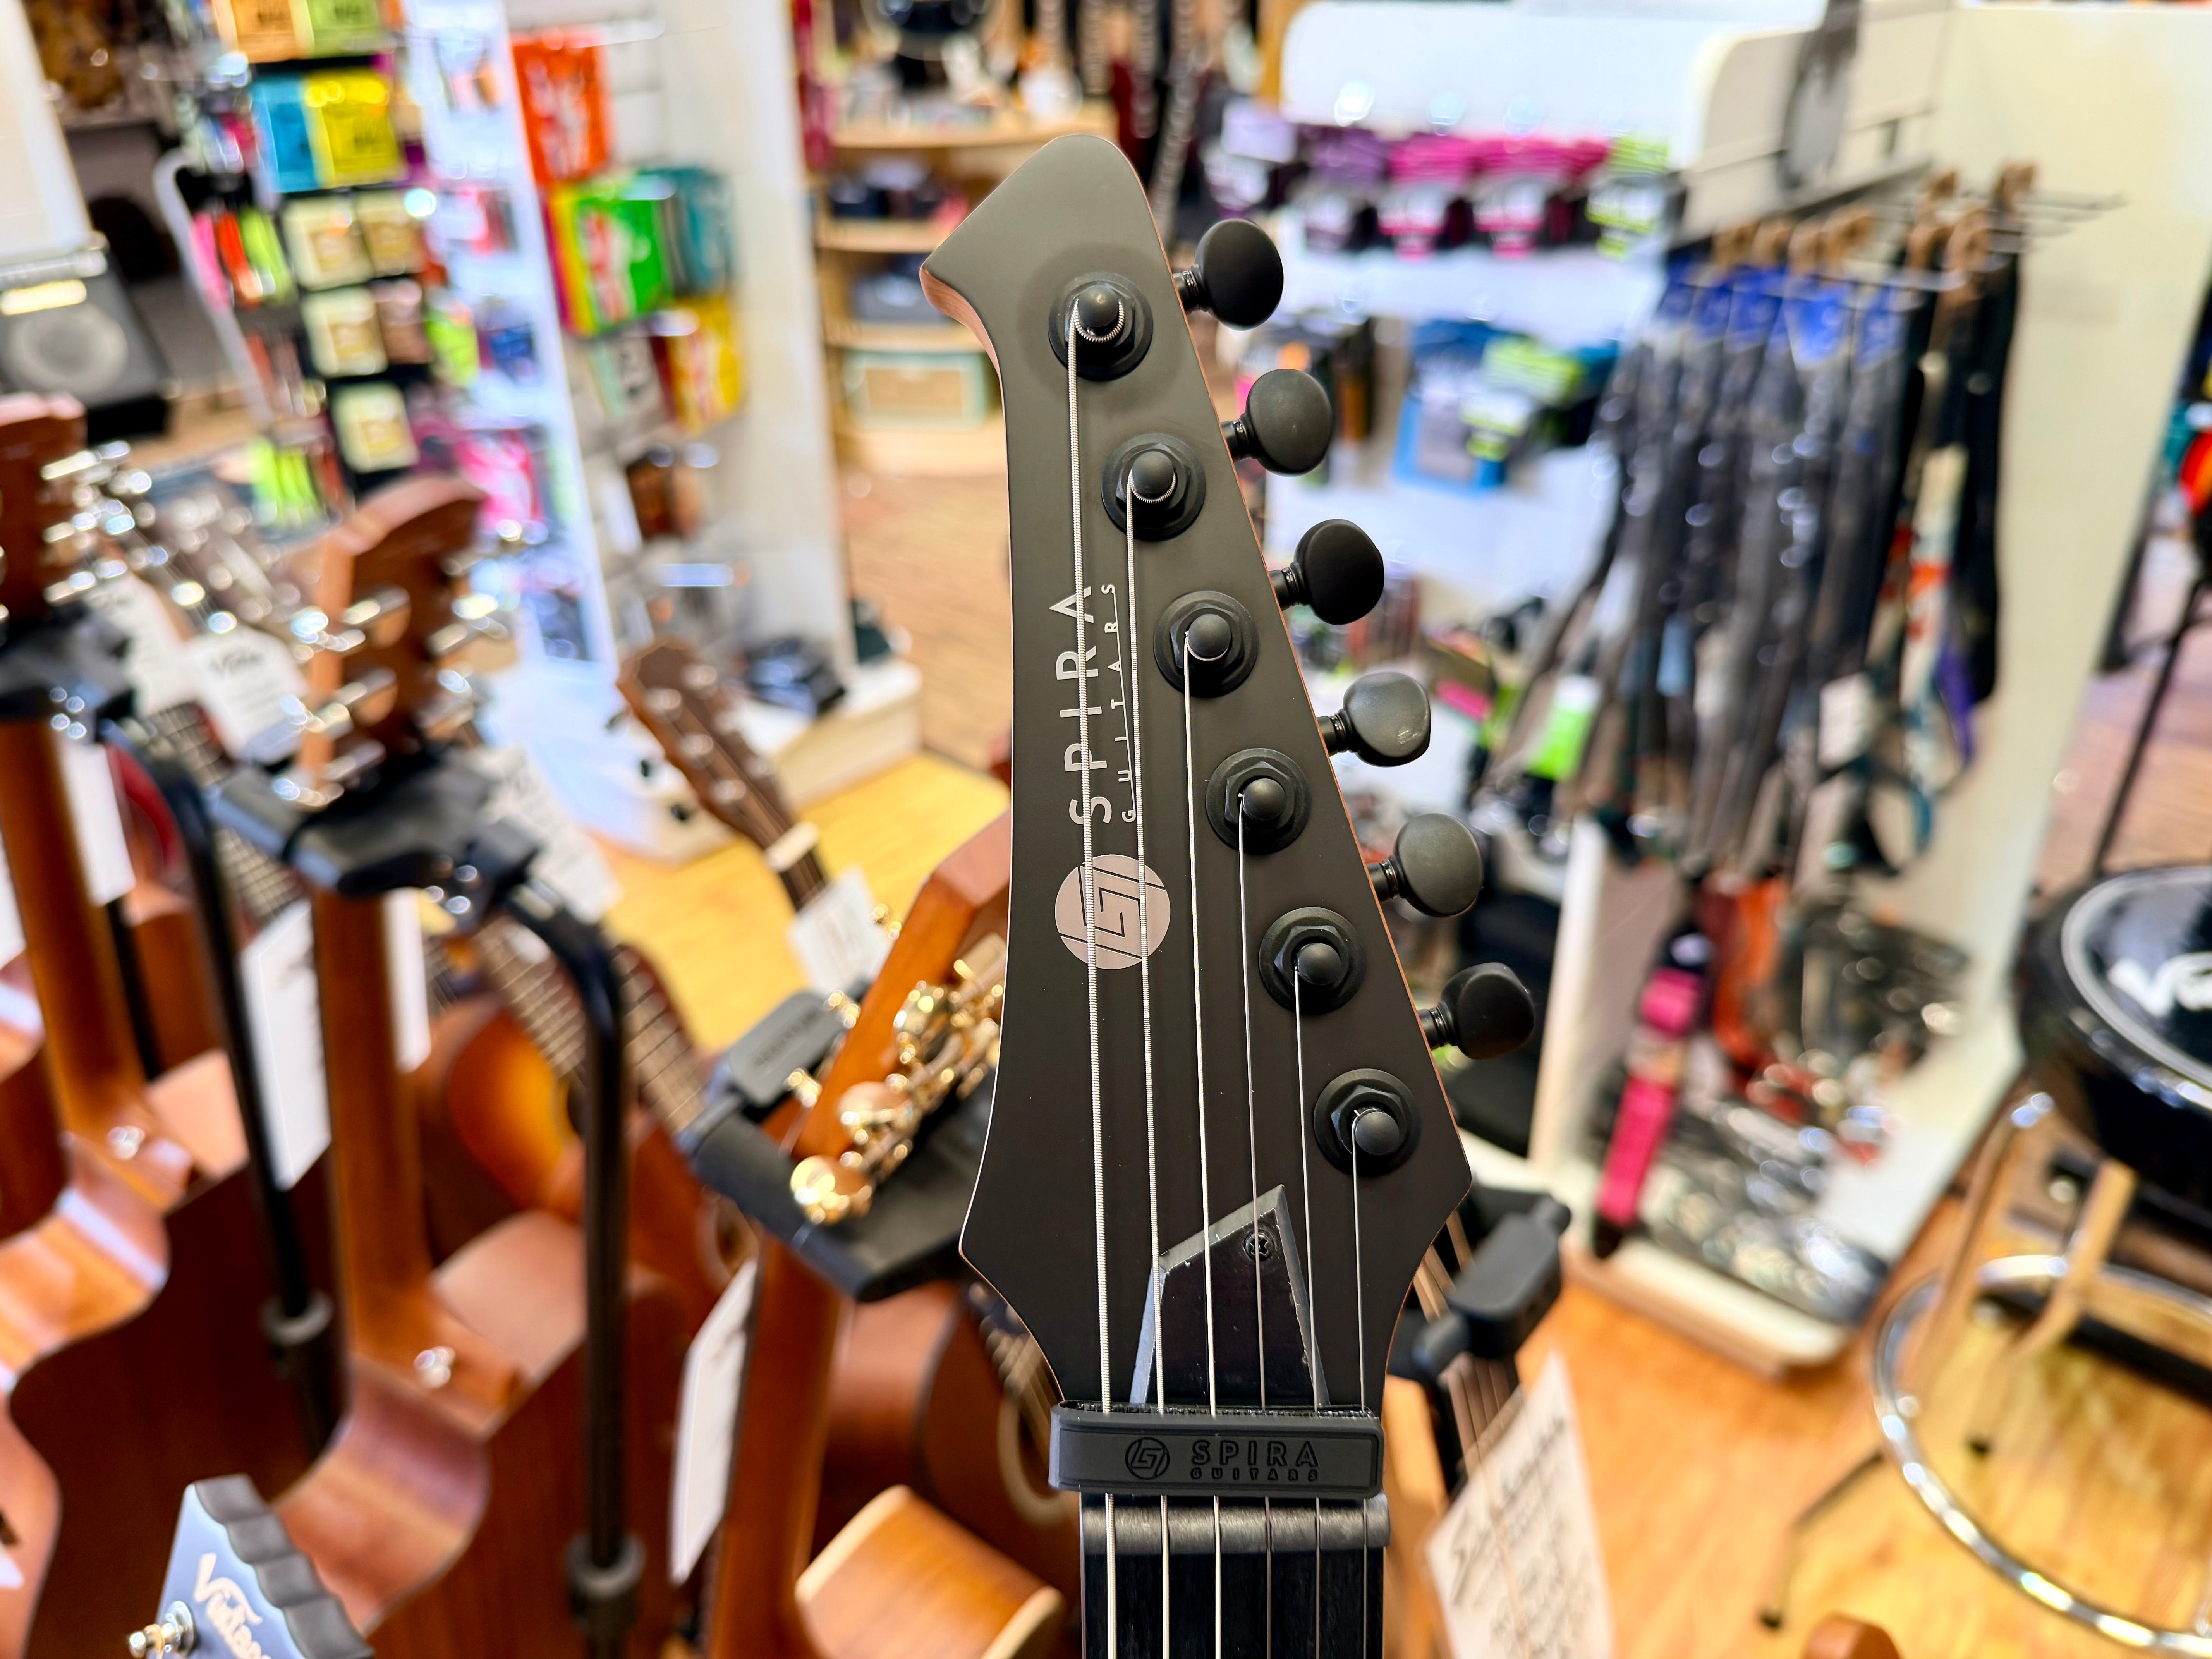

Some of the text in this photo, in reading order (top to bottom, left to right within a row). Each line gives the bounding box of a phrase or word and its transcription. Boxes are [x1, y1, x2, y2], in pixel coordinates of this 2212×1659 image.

[1049, 586, 1112, 824] SPIRA
[1101, 584, 1136, 823] GUITARS
[1190, 1468, 1318, 1482] GUITARS
[1191, 1440, 1318, 1467] SPIRA
